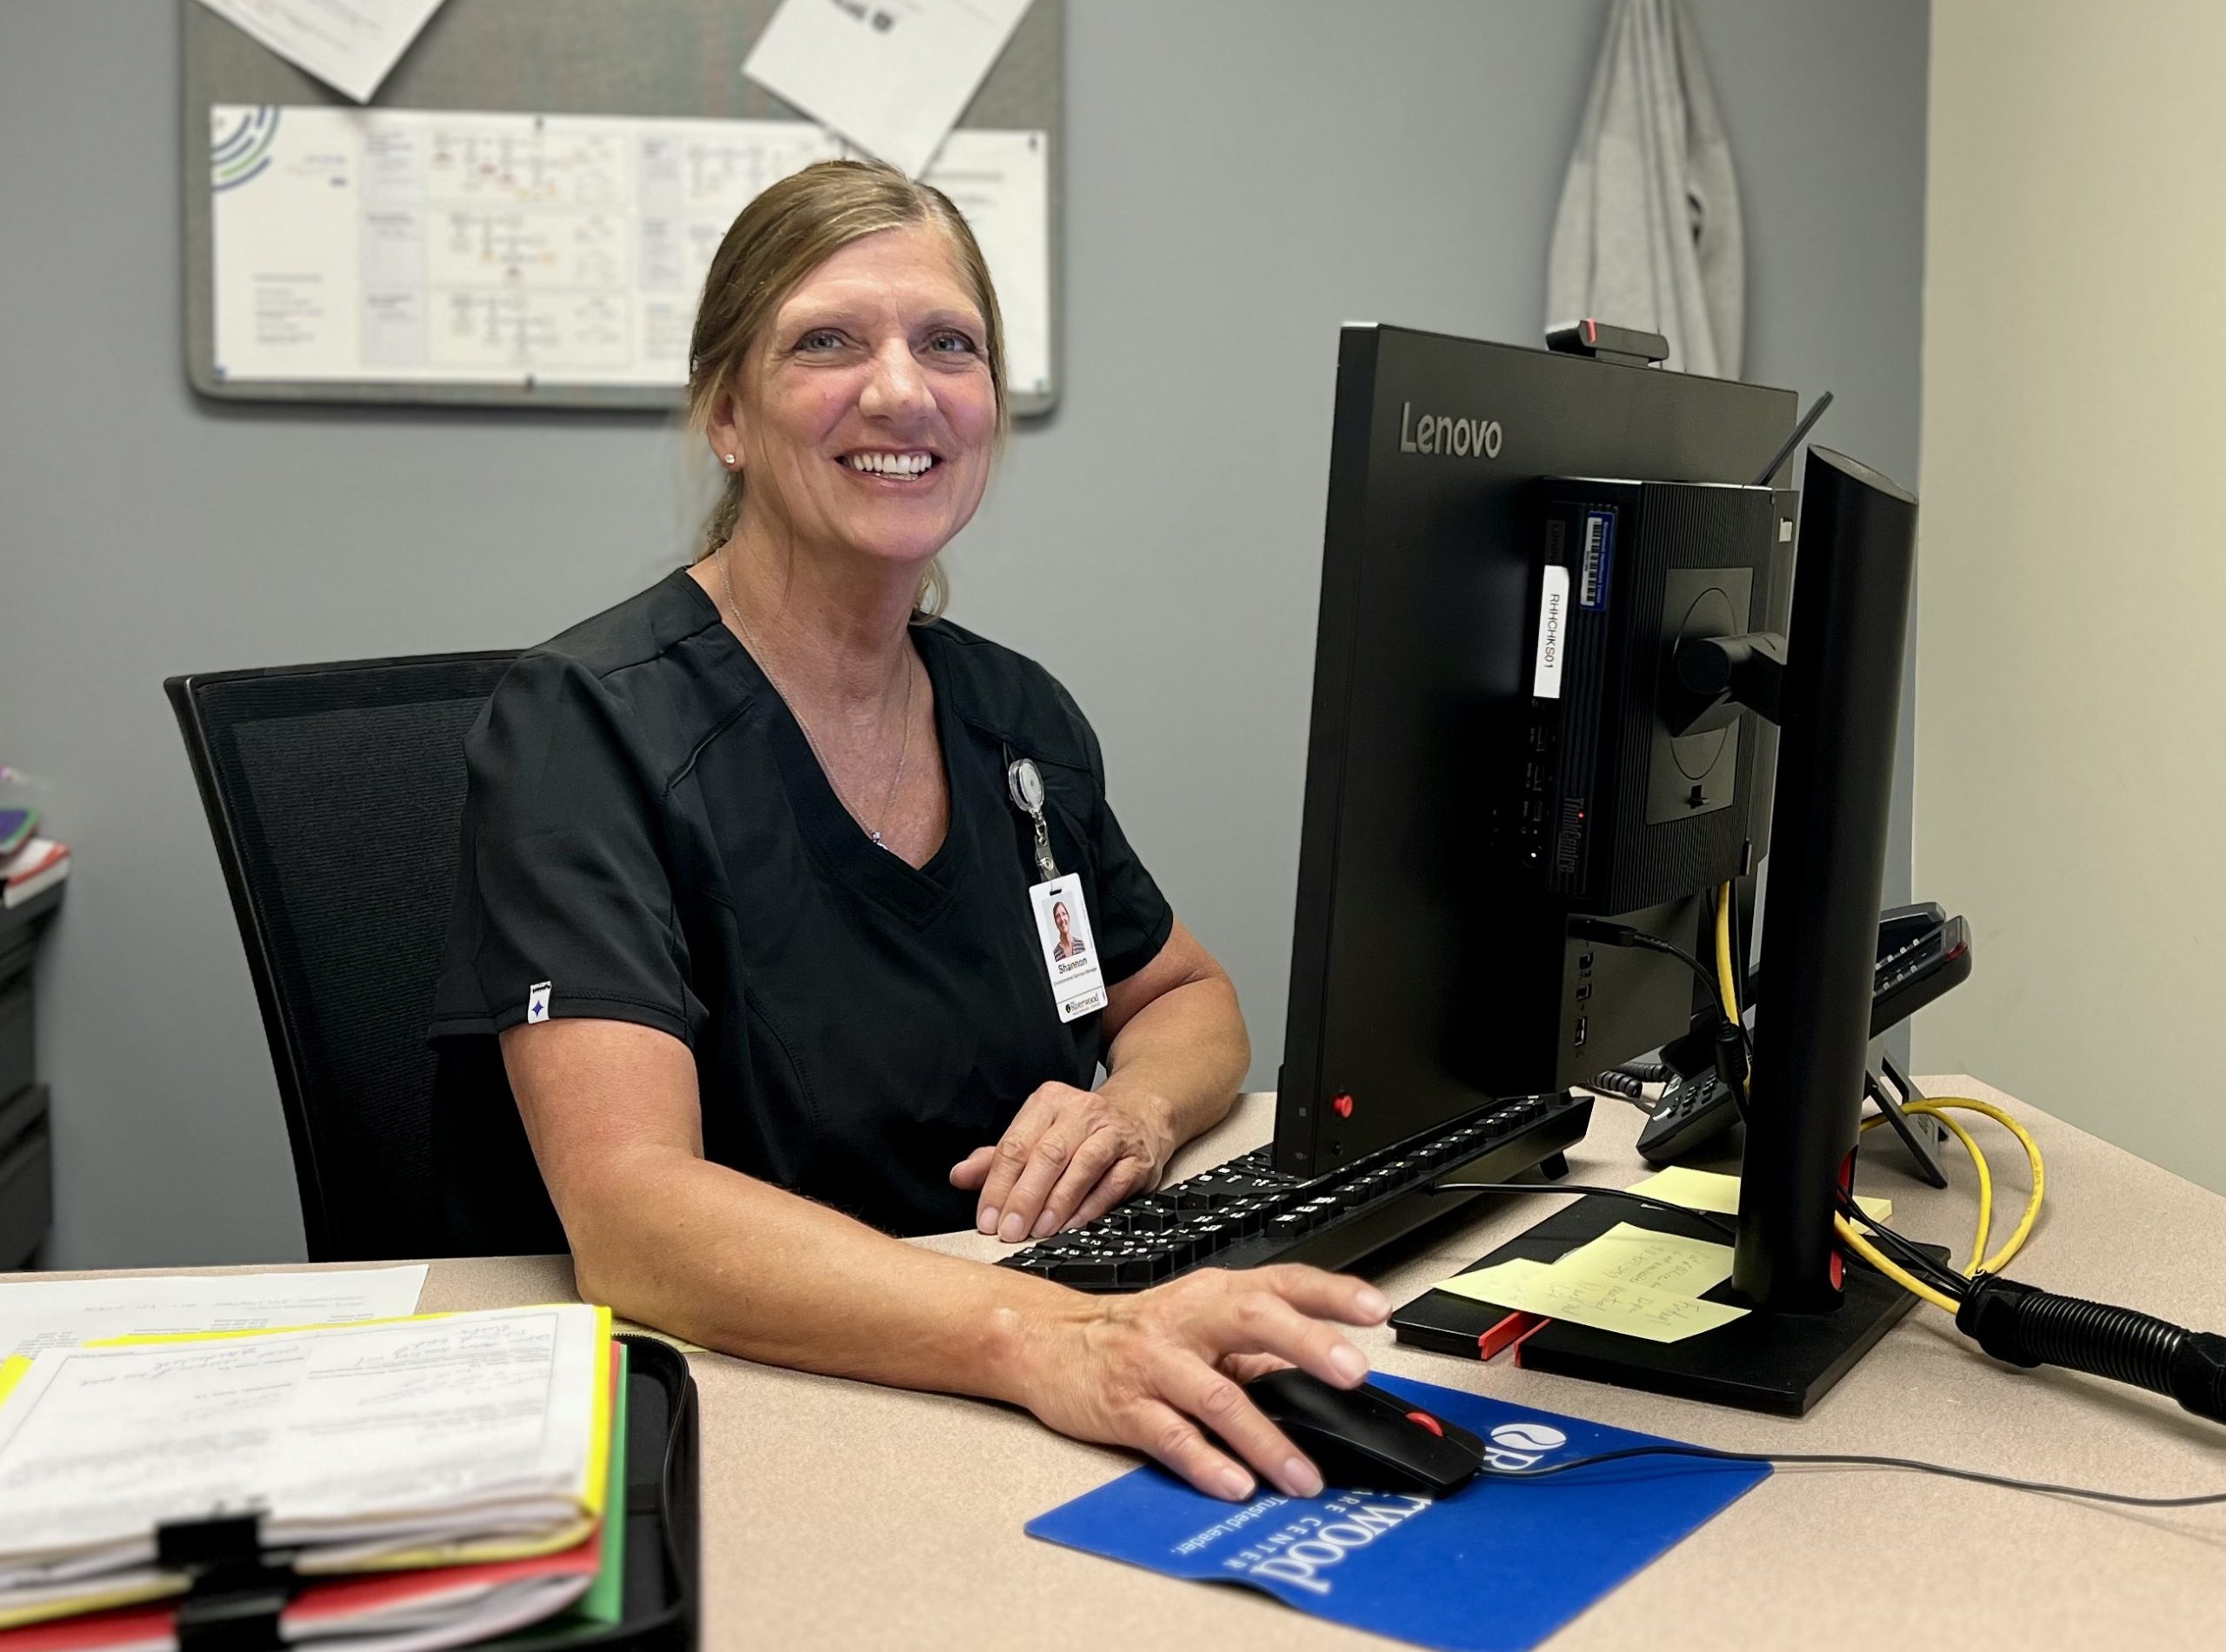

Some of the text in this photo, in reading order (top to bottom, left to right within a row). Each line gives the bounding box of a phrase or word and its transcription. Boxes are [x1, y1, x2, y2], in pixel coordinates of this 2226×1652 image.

[1400, 402, 1503, 459] Lenovo
[1543, 593, 1561, 669] RHHCHKS01
[1558, 797, 1584, 873] ThinkCentre
[1058, 957, 1088, 975] Shannon
[1225, 1496, 1289, 1529] Trusted
[1223, 1517, 1322, 1569] CENTER
